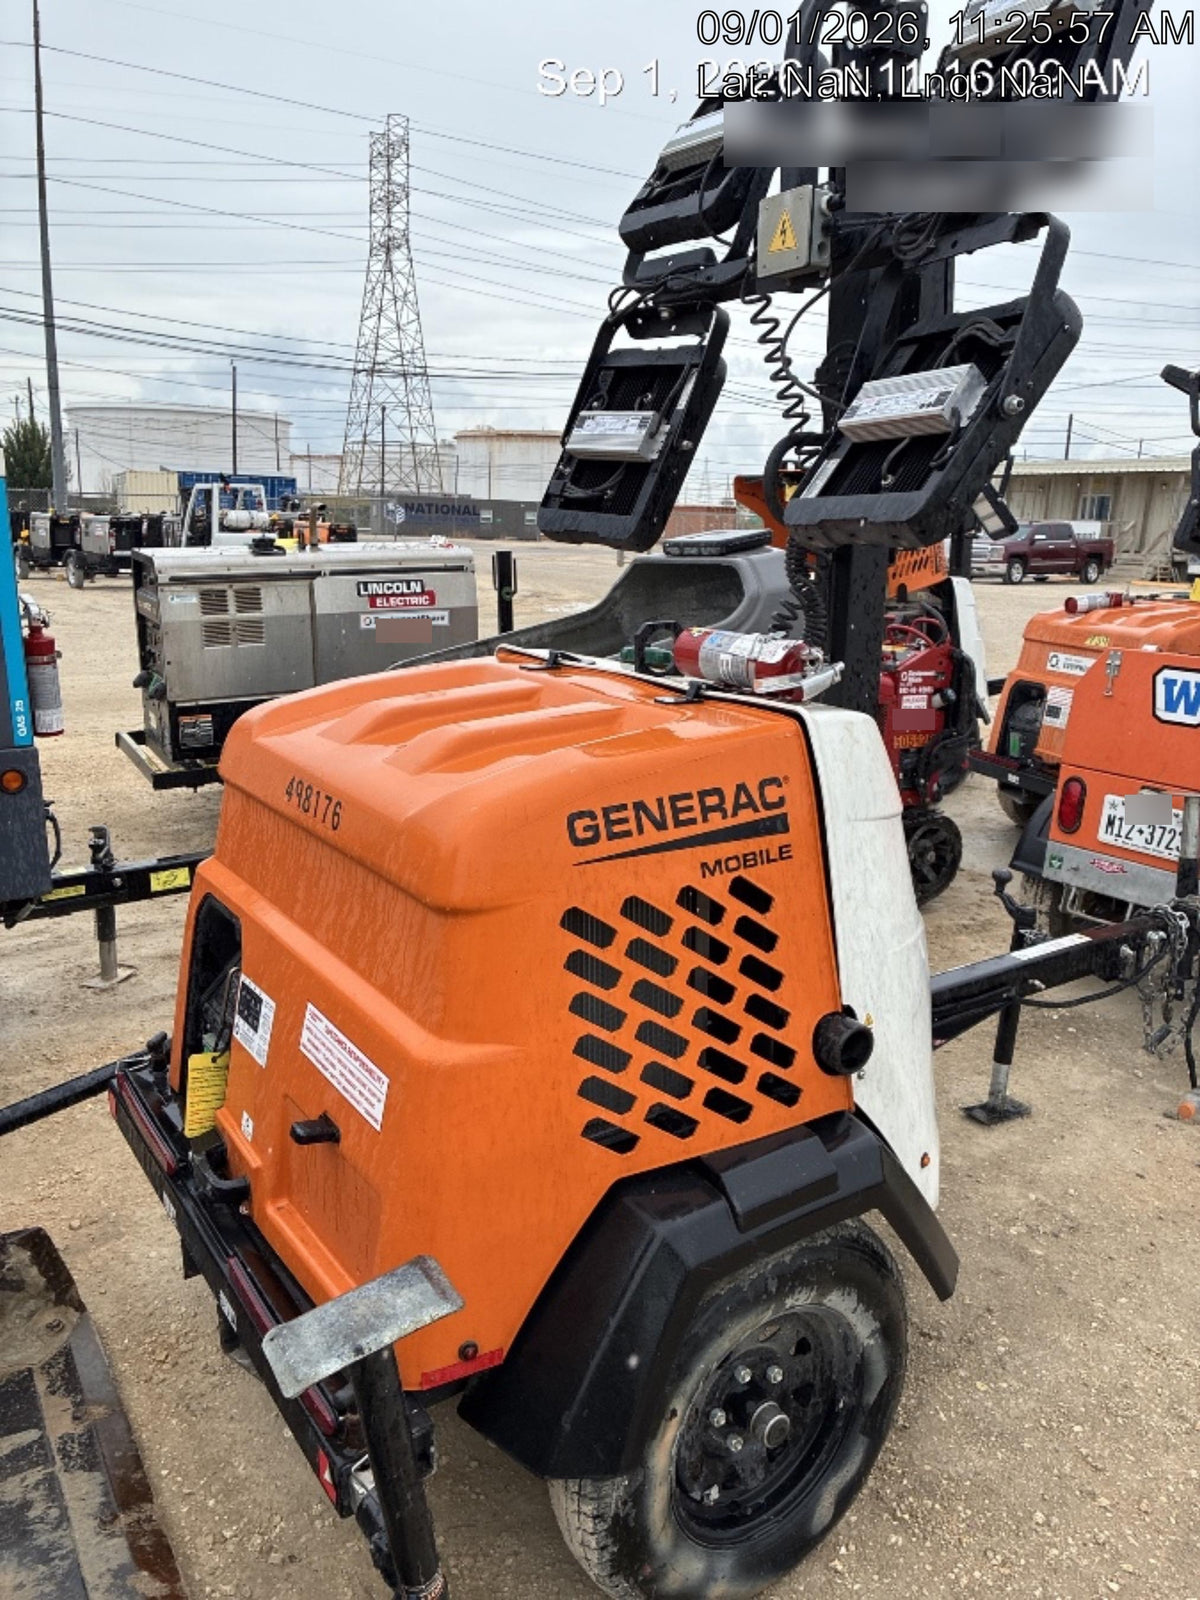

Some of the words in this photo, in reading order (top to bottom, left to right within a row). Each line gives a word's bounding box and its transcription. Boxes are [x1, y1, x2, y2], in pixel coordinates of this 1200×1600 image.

[404, 502, 481, 516] NATIONAL
[360, 581, 422, 595] LINCOLN
[375, 595, 430, 607] ELECTRIC
[285, 775, 343, 831] 498176
[566, 776, 786, 848] GENERAC
[700, 843, 794, 879] MOBILE
